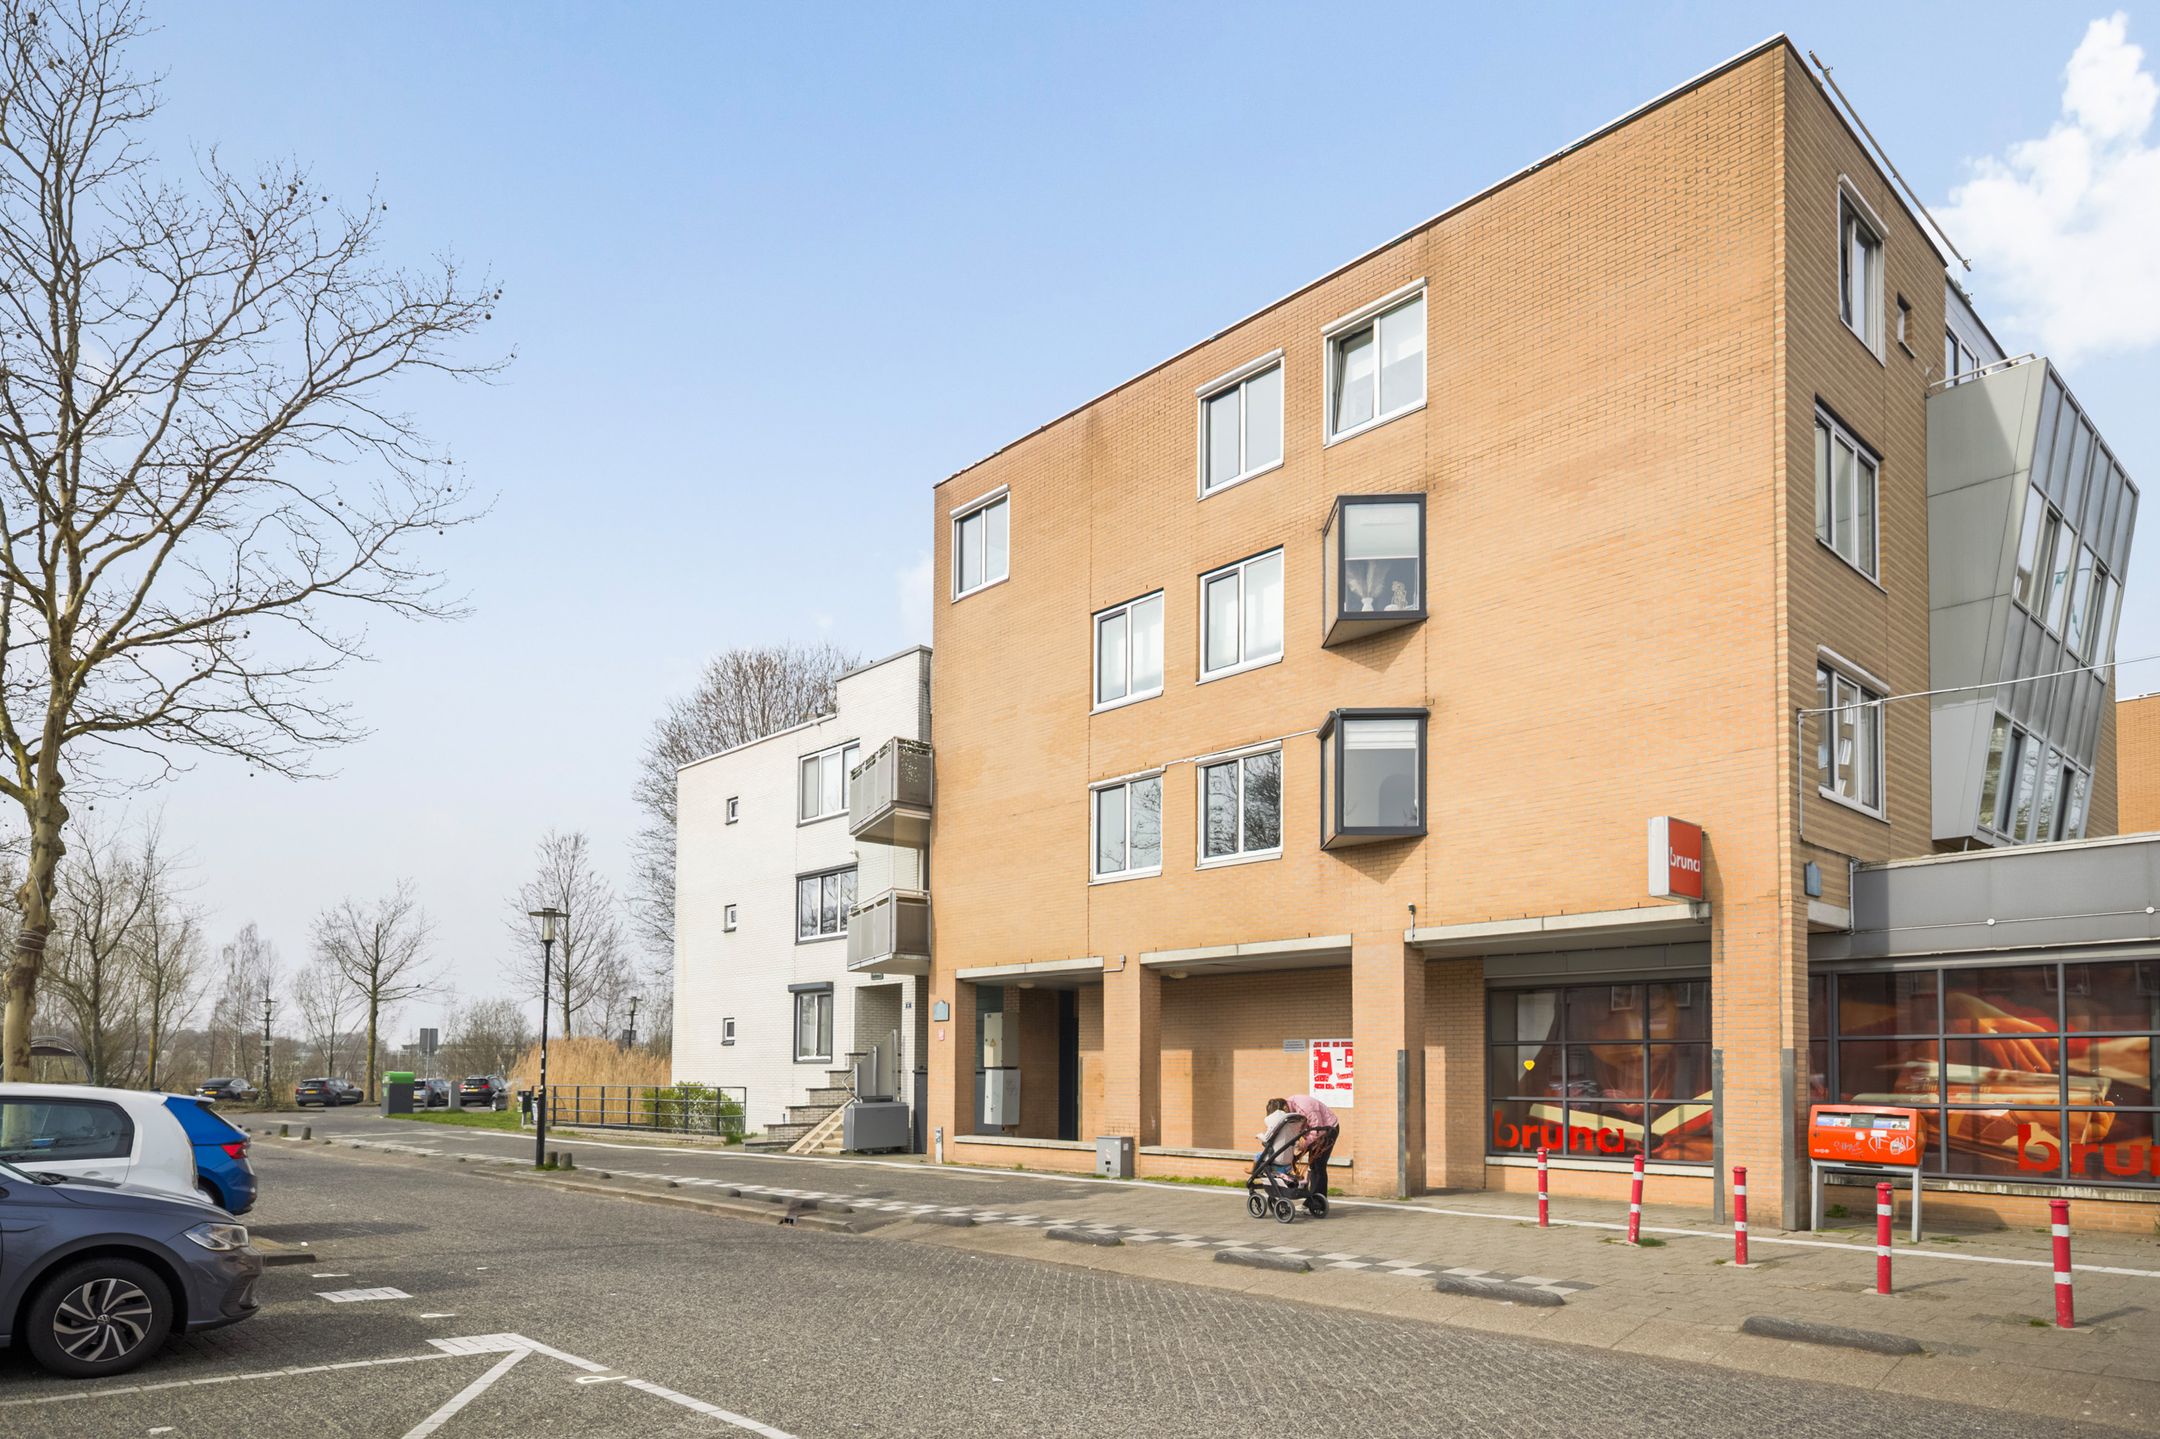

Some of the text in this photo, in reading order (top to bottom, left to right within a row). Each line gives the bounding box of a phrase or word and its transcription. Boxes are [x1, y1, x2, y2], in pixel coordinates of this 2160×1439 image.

[1669, 846, 1701, 872] bruna
[1493, 1109, 1625, 1153] bruna
[2017, 1123, 2160, 1177] bru
